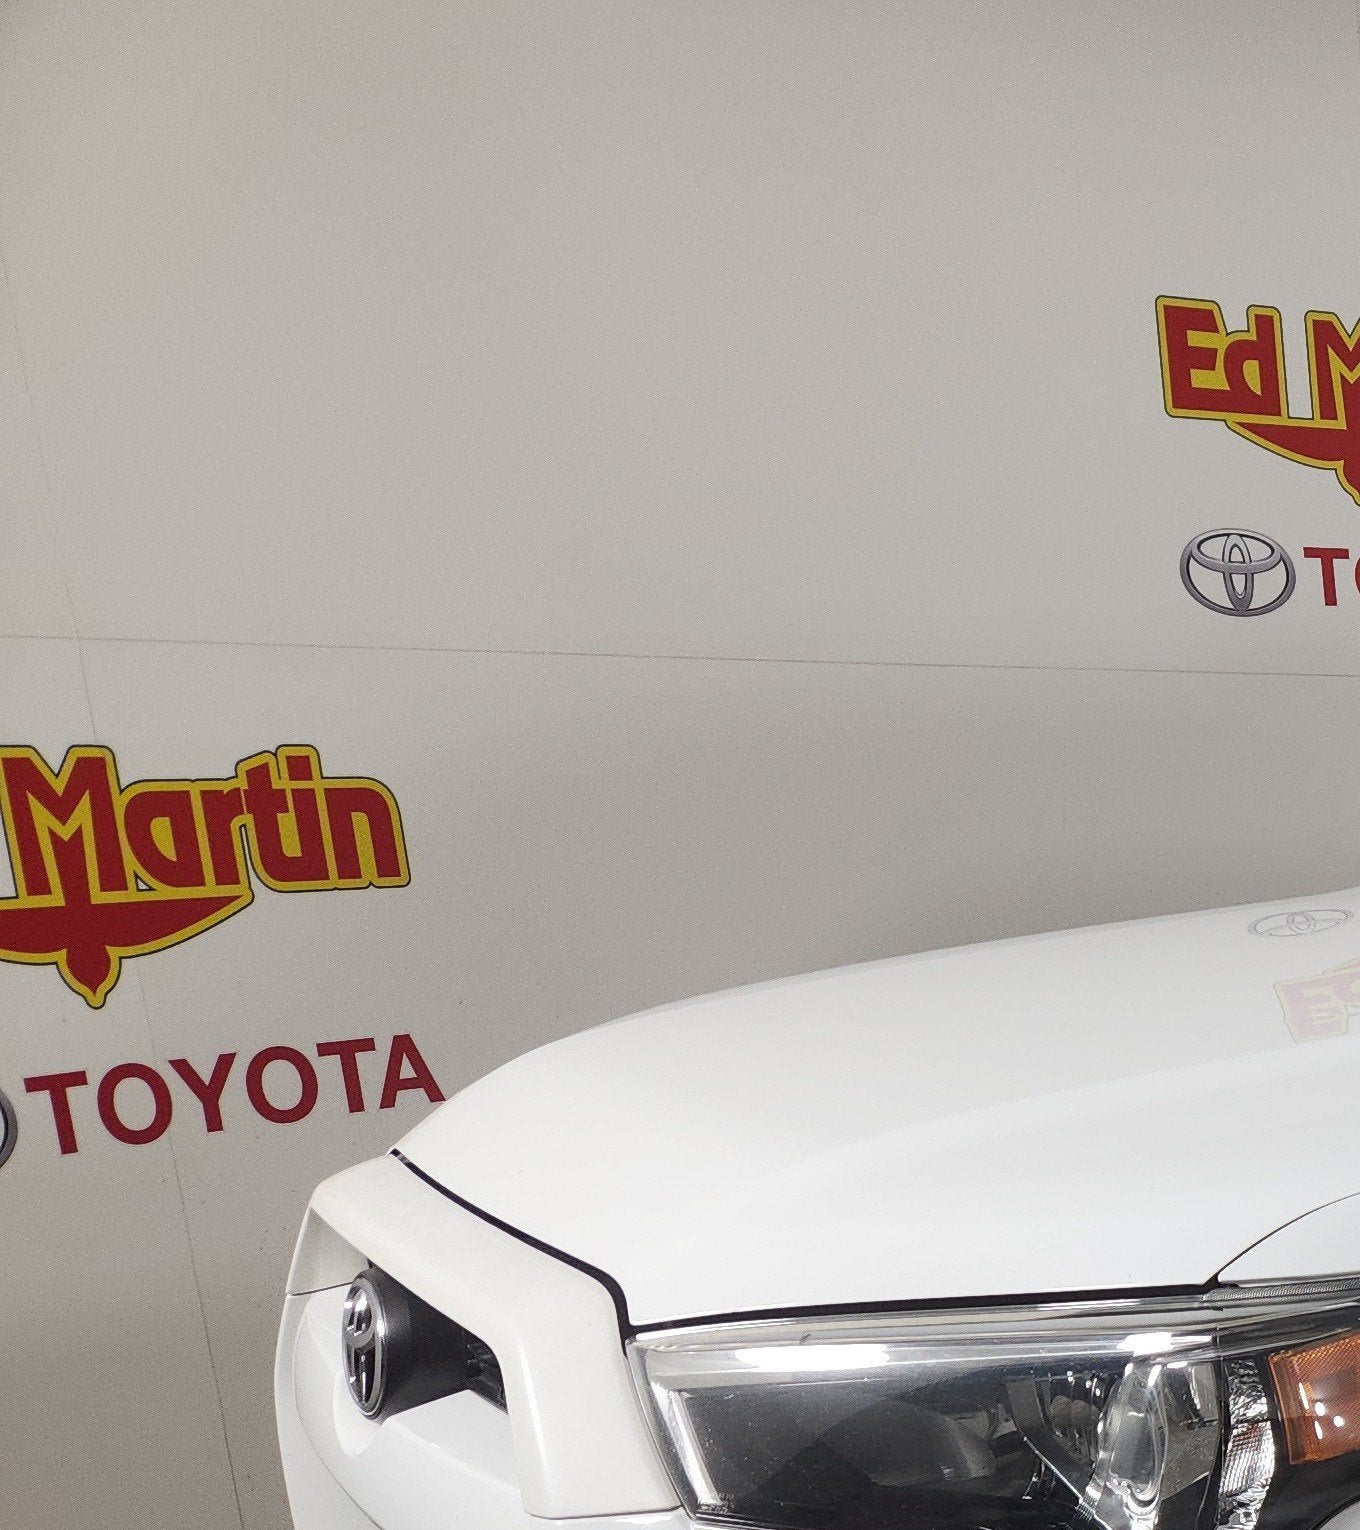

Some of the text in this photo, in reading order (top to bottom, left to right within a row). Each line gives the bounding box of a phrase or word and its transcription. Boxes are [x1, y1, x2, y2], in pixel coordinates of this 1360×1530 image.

[1161, 303, 1283, 418] Ed
[0, 753, 404, 898] Martin
[22, 1033, 448, 1156] TOYOTA
